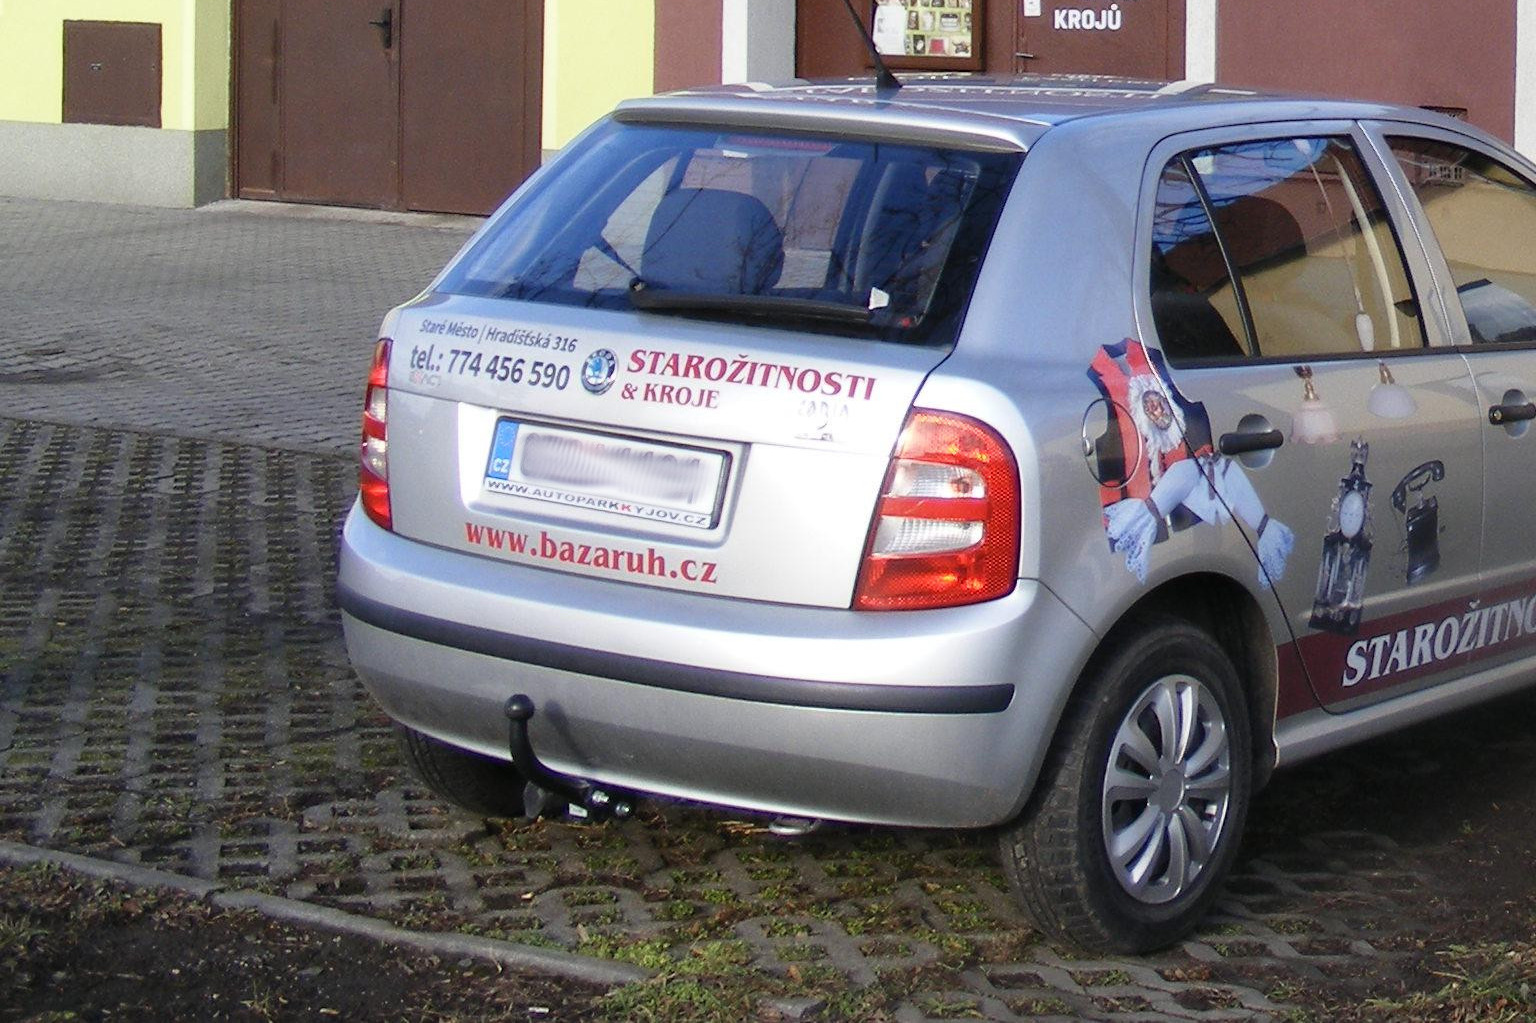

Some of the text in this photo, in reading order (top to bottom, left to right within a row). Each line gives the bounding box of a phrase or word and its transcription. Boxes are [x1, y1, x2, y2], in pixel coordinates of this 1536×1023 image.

[1054, 3, 1121, 30] KROJŮ
[420, 319, 447, 334] Staré
[552, 336, 578, 353] 316
[410, 344, 570, 391] tel.: 774 456 590
[626, 348, 878, 401] STAROŽITNOSTI
[621, 381, 721, 411] & KROJE
[491, 458, 509, 473] CZ
[487, 480, 706, 525] WWW.AUTOPARKKYJOV.CZ
[464, 522, 718, 584] www.bazaruh.cz
